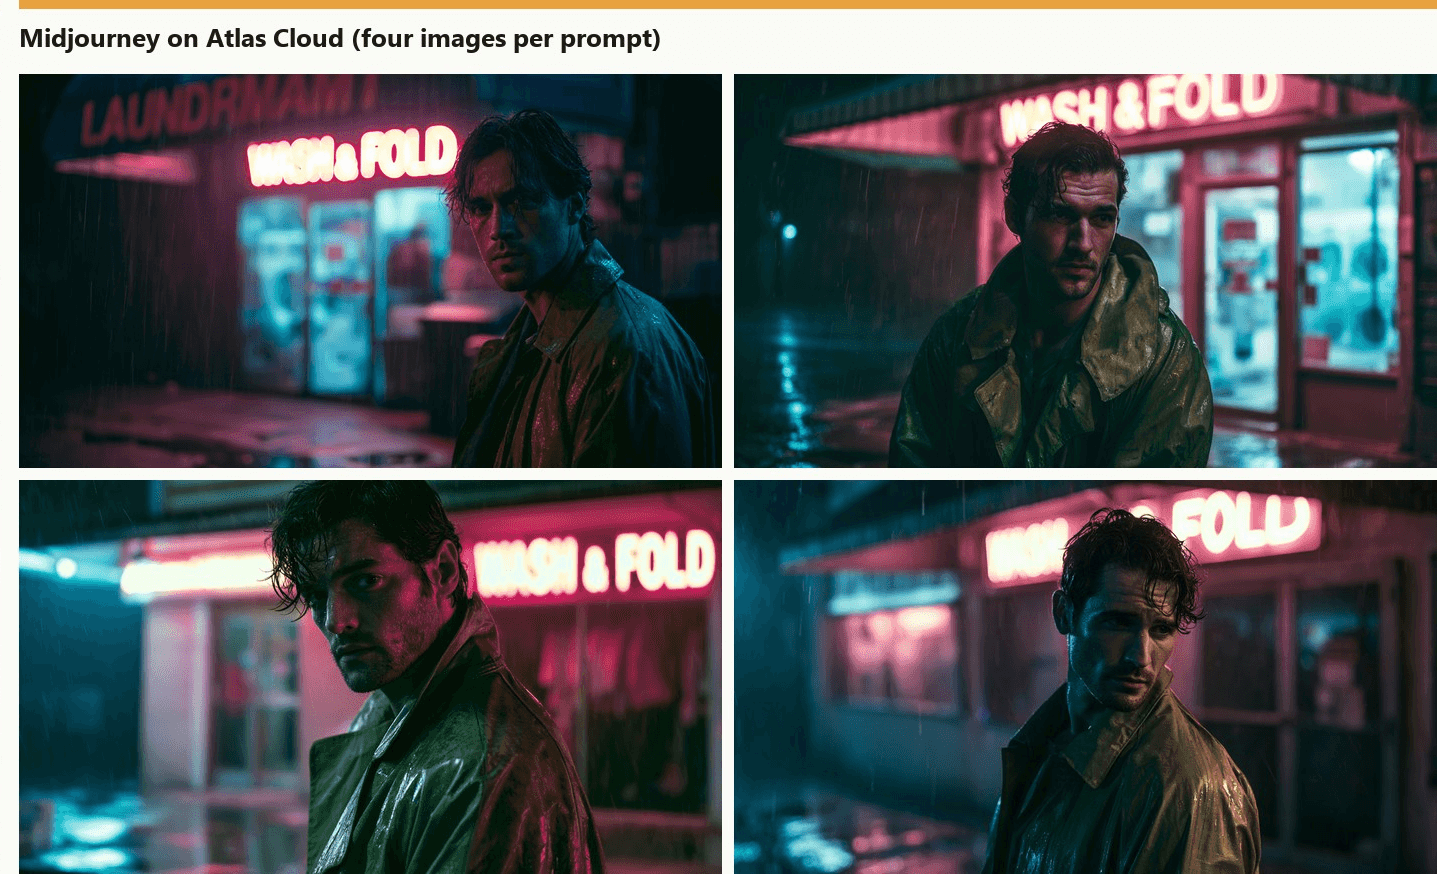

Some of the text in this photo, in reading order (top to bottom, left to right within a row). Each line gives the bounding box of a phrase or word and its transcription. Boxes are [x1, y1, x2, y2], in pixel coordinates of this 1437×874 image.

[1113, 79, 1146, 132] &
[1146, 74, 1280, 130] FOLD
[247, 135, 335, 187] WASH
[361, 125, 458, 179] FOLD
[473, 529, 716, 599] WASH & FOLD
